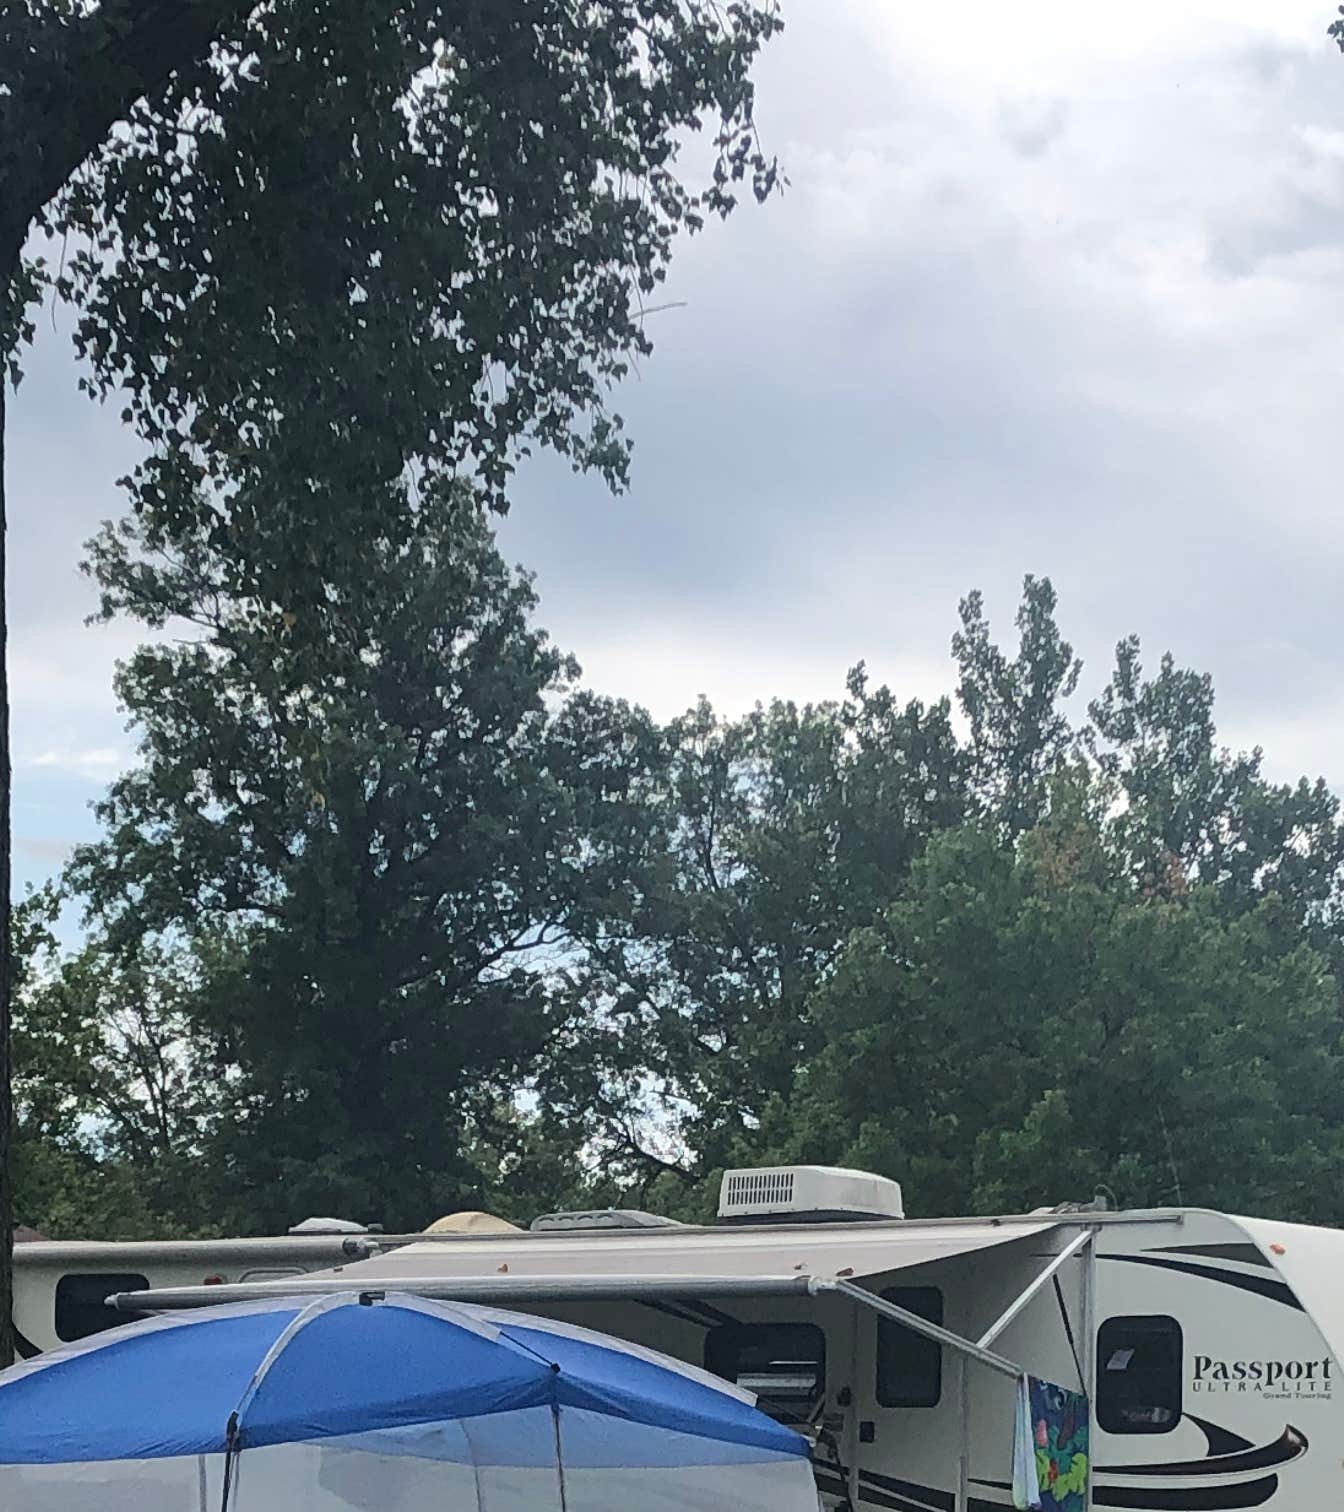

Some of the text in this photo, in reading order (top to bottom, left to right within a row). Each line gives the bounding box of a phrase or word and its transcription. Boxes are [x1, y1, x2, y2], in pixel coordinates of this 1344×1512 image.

[1193, 1355, 1333, 1386] Passport
[1192, 1381, 1332, 1392] ULTRA LITE
